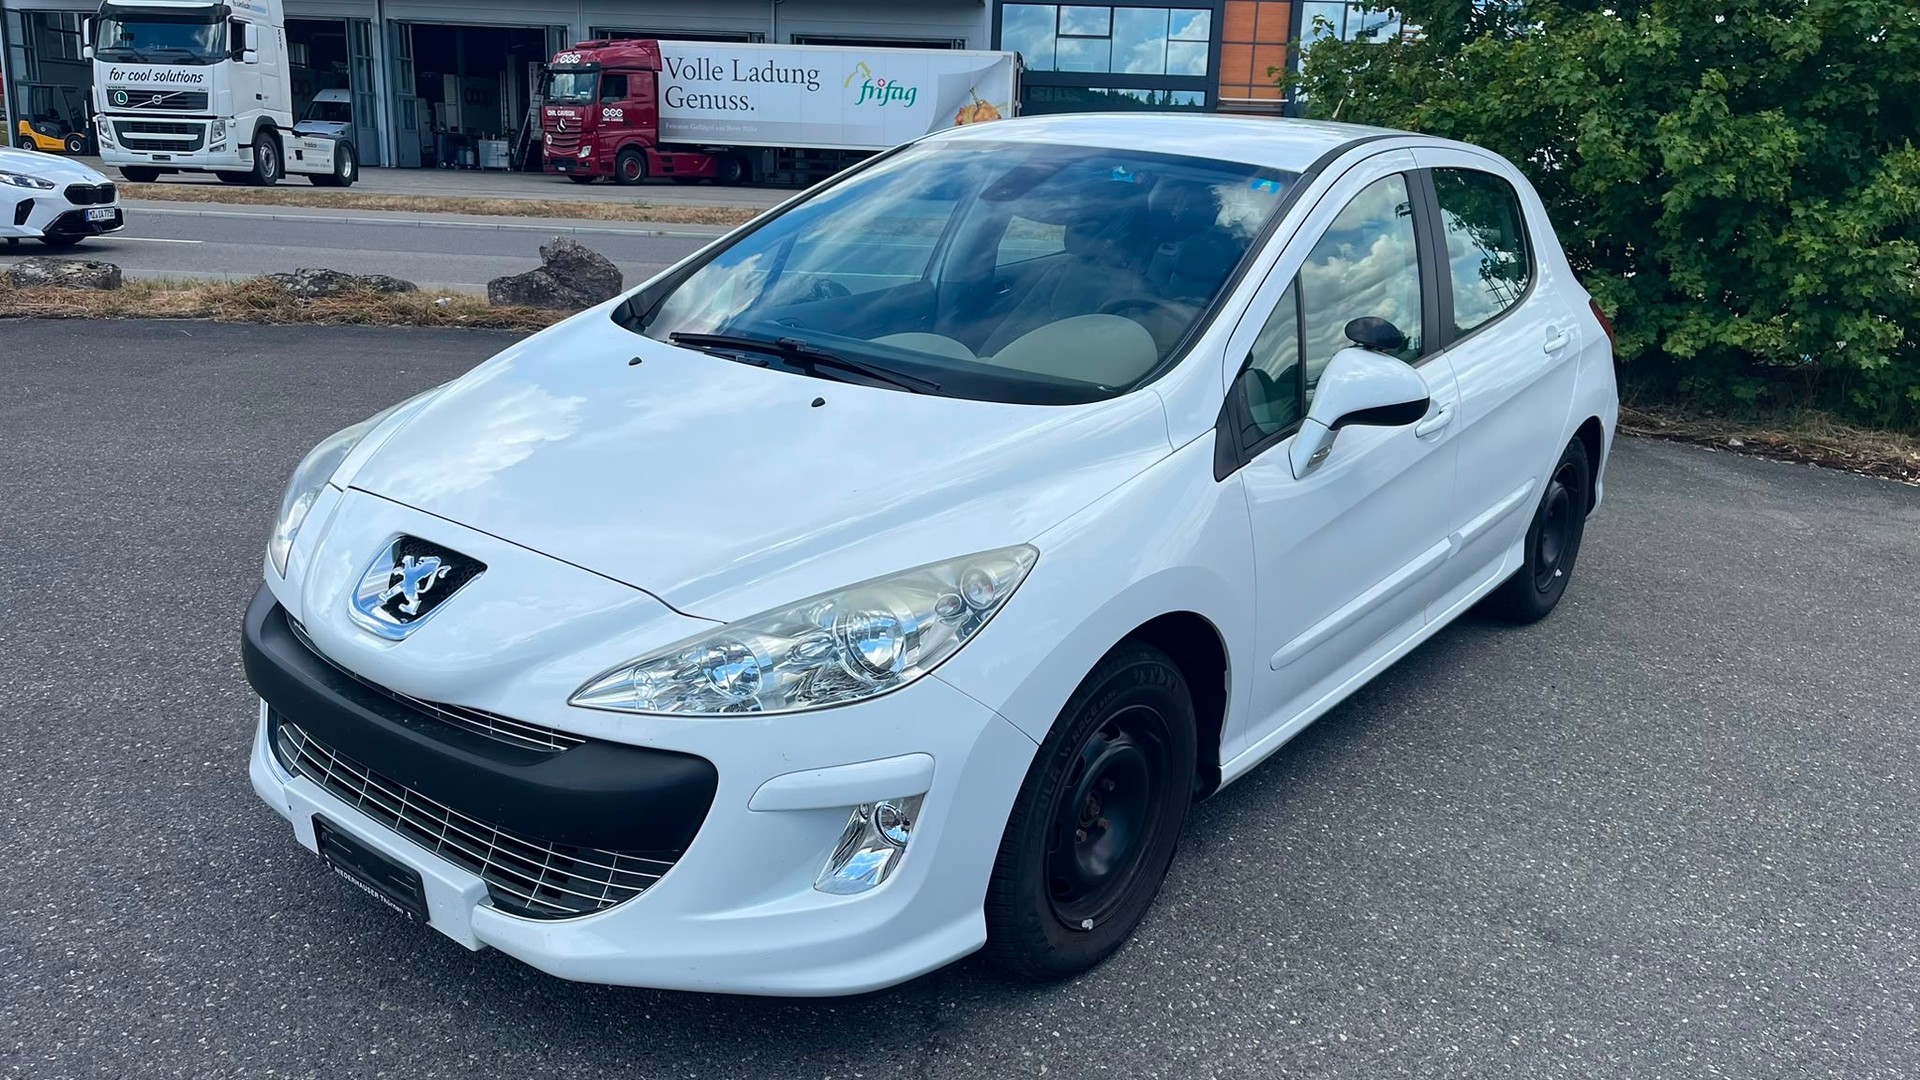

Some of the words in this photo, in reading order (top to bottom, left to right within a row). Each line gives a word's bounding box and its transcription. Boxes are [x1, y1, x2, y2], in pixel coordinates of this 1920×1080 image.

[109, 67, 125, 80] for
[127, 68, 153, 81] cool
[153, 69, 204, 83] solutions
[664, 57, 724, 82] Volle
[732, 58, 820, 92] Ladung
[117, 93, 124, 102] L
[665, 85, 755, 111] Genuss.
[855, 78, 918, 108] frifag
